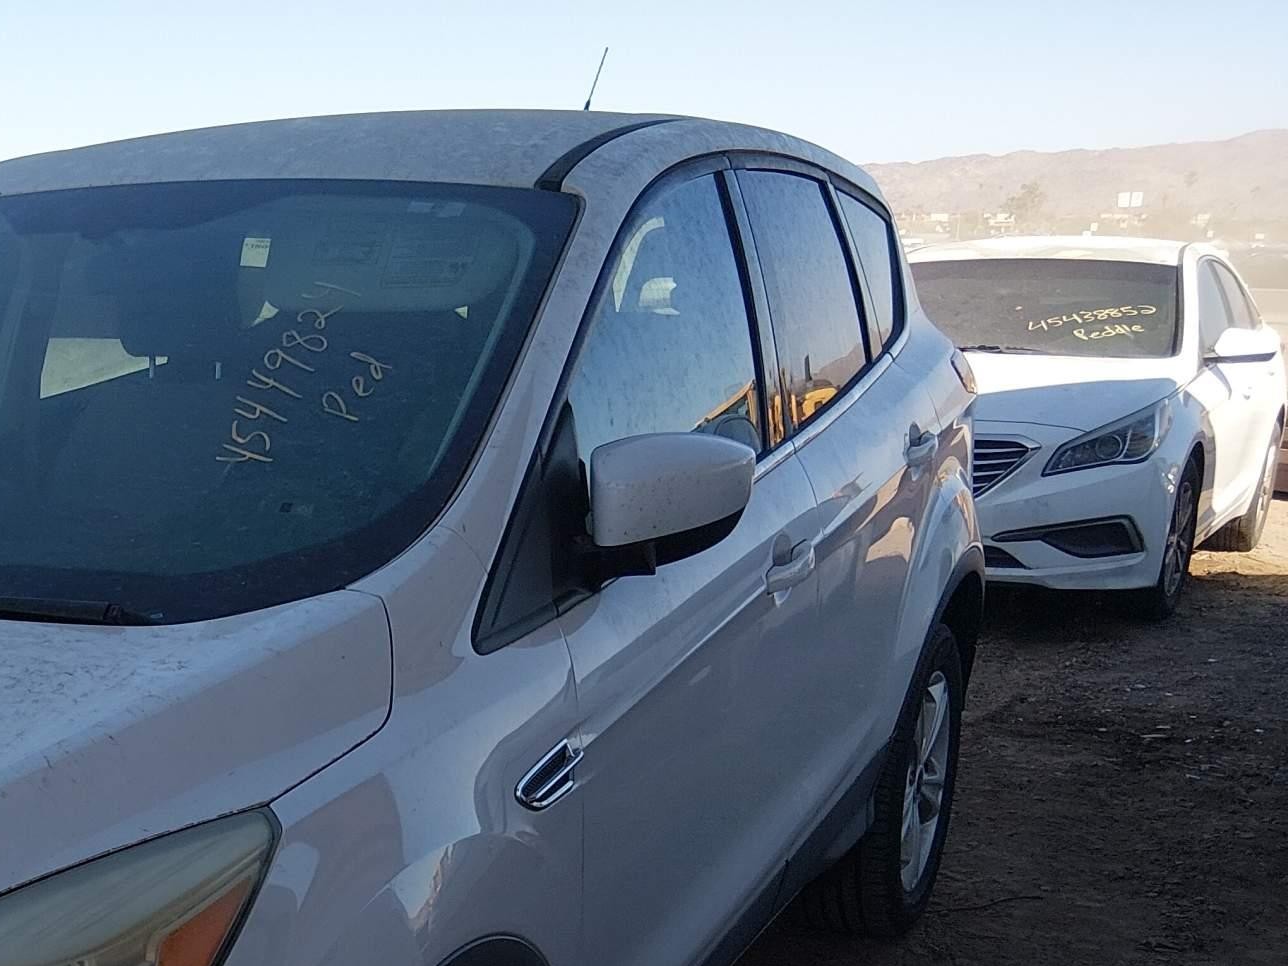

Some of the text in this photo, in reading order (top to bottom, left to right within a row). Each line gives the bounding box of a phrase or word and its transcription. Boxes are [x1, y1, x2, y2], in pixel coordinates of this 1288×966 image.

[1027, 304, 1158, 332] 45438852
[1072, 323, 1145, 341] Peddle
[215, 280, 362, 462] 45449824
